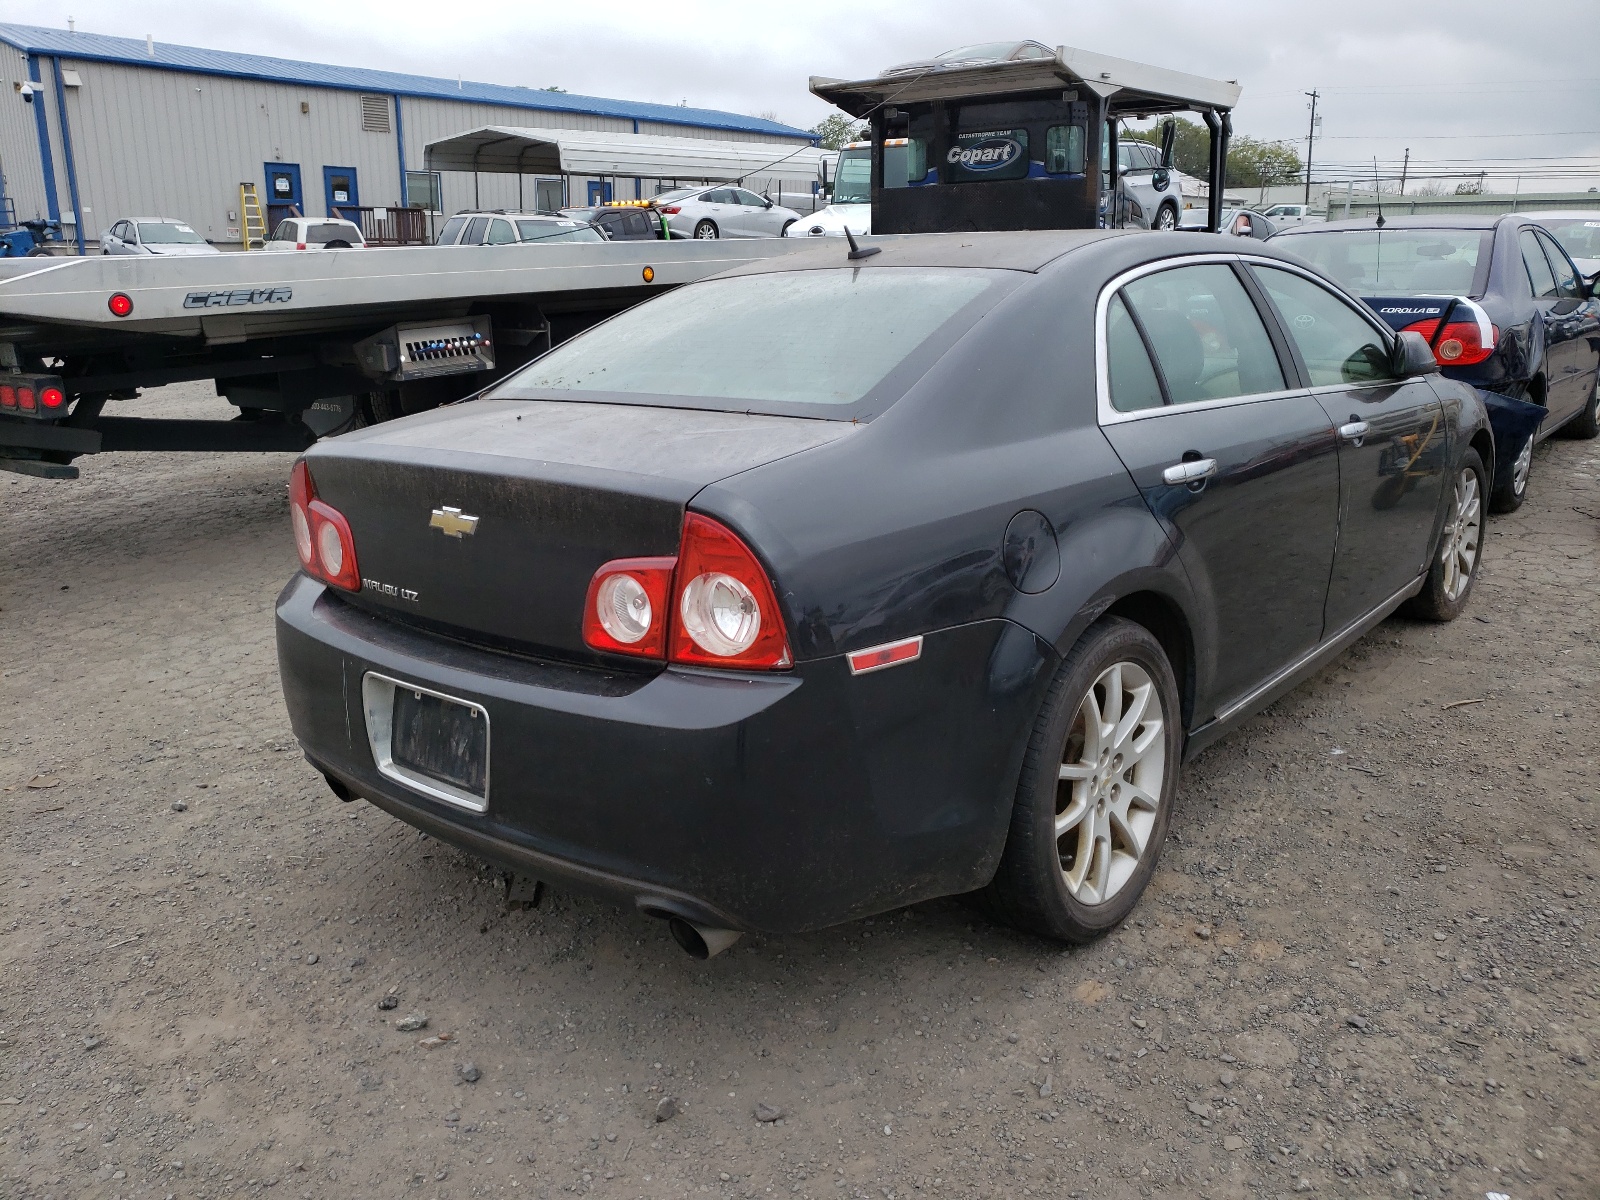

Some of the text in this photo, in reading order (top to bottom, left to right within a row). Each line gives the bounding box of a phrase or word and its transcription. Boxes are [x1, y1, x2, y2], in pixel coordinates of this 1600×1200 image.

[996, 129, 1013, 137] TEAM
[947, 142, 1012, 165] Copart
[362, 578, 419, 602] MALIBU LTZ
